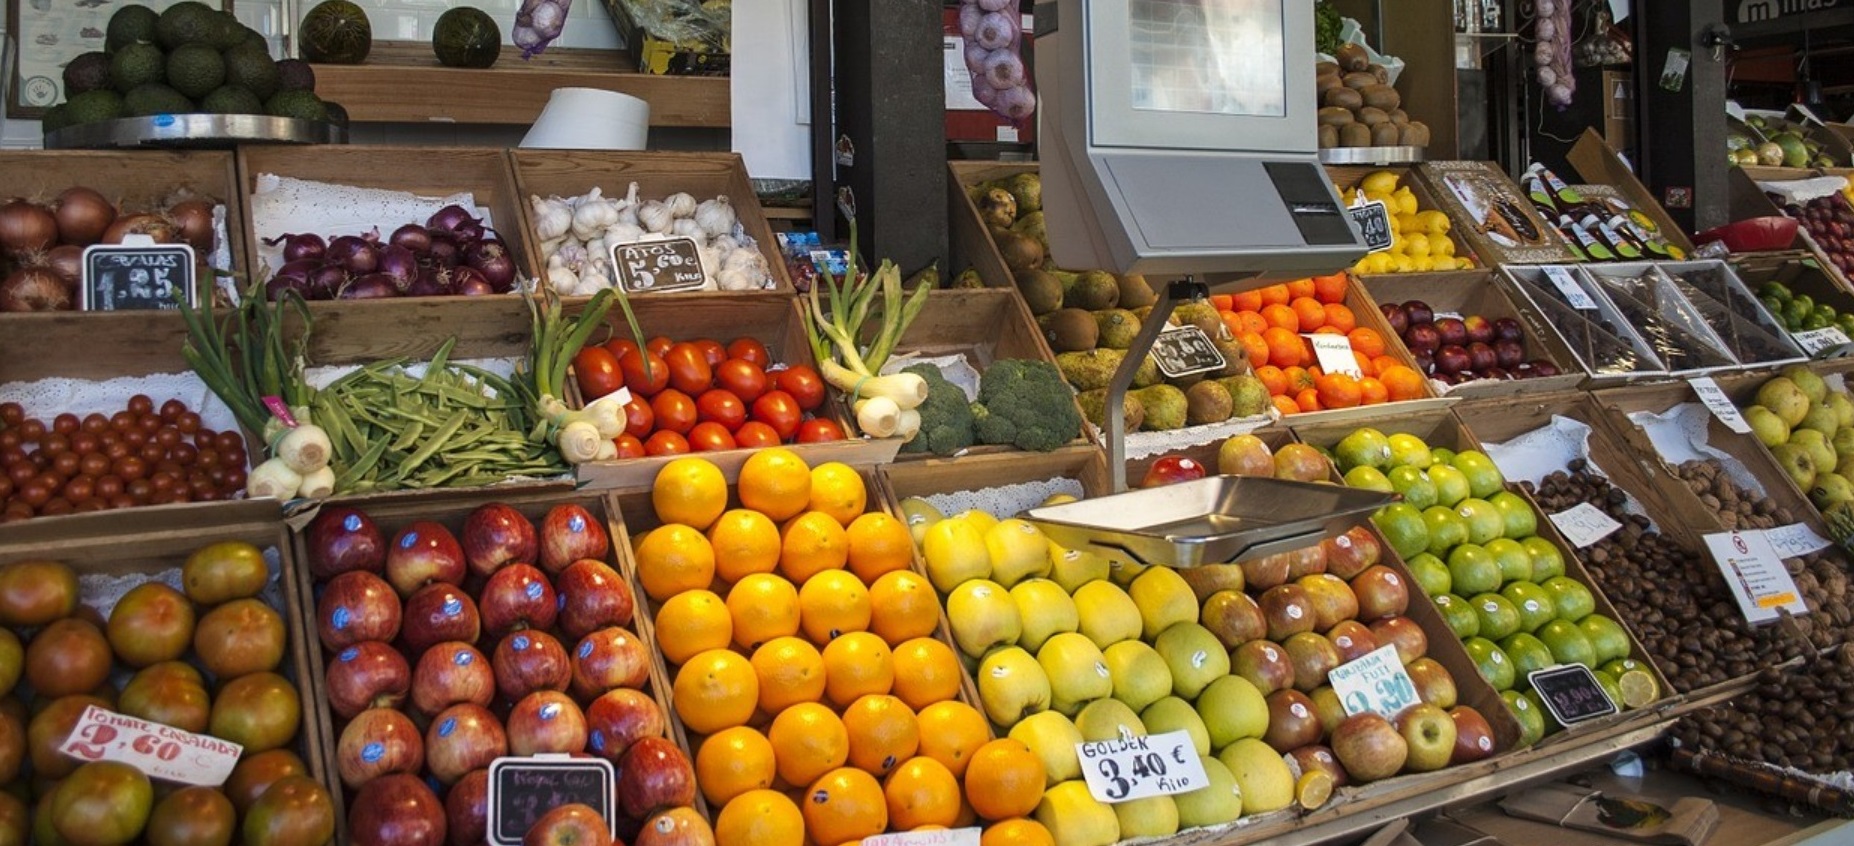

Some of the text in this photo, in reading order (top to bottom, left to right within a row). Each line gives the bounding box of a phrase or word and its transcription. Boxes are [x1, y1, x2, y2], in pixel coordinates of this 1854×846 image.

[88, 707, 239, 758] TOMATE ENSALADA
[1082, 734, 1149, 758] GOLDEN
[1098, 745, 1186, 799] 3,40 €
